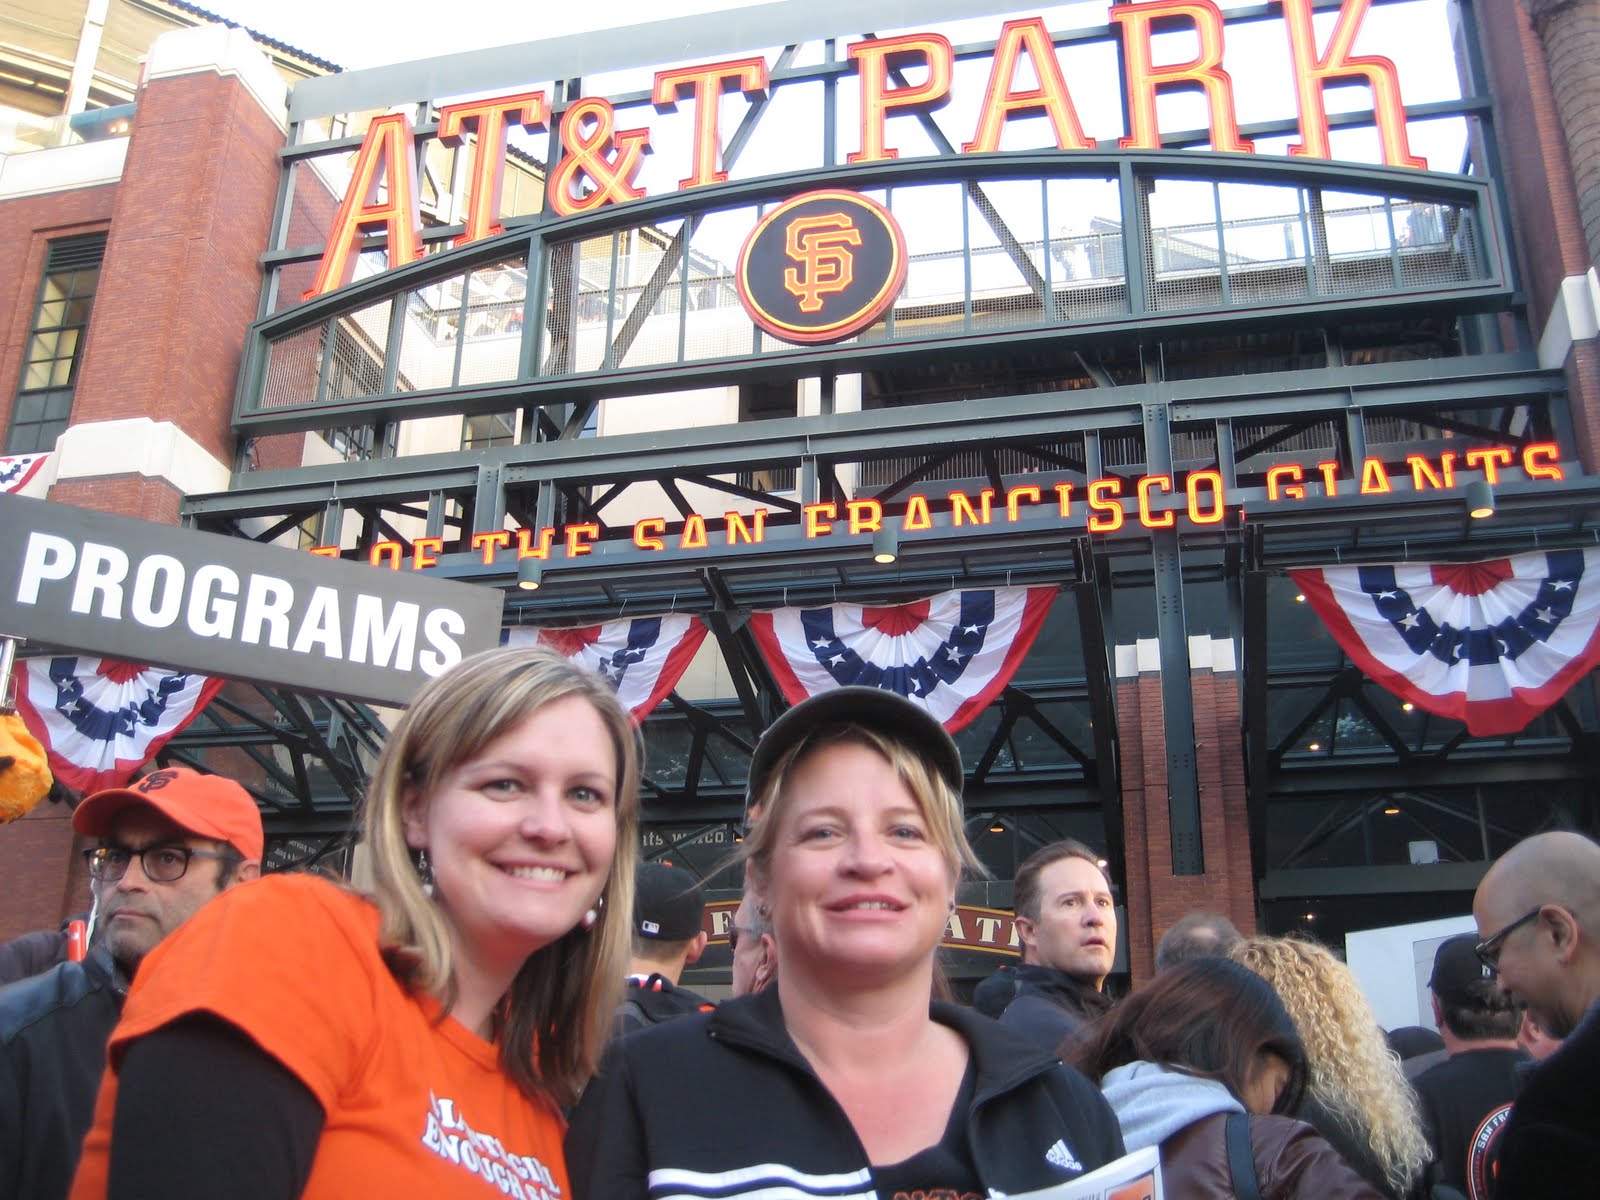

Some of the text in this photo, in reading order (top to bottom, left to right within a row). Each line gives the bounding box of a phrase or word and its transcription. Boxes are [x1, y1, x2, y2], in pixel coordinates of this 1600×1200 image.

[303, 0, 1428, 301] AT&T PARK
[472, 521, 600, 565] THE
[632, 508, 768, 551] SAN
[803, 469, 1225, 539] FRANCISCO
[1267, 442, 1563, 501] GIANTS
[16, 531, 466, 678] PROGRAMS
[1477, 1125, 1494, 1149] SAN
